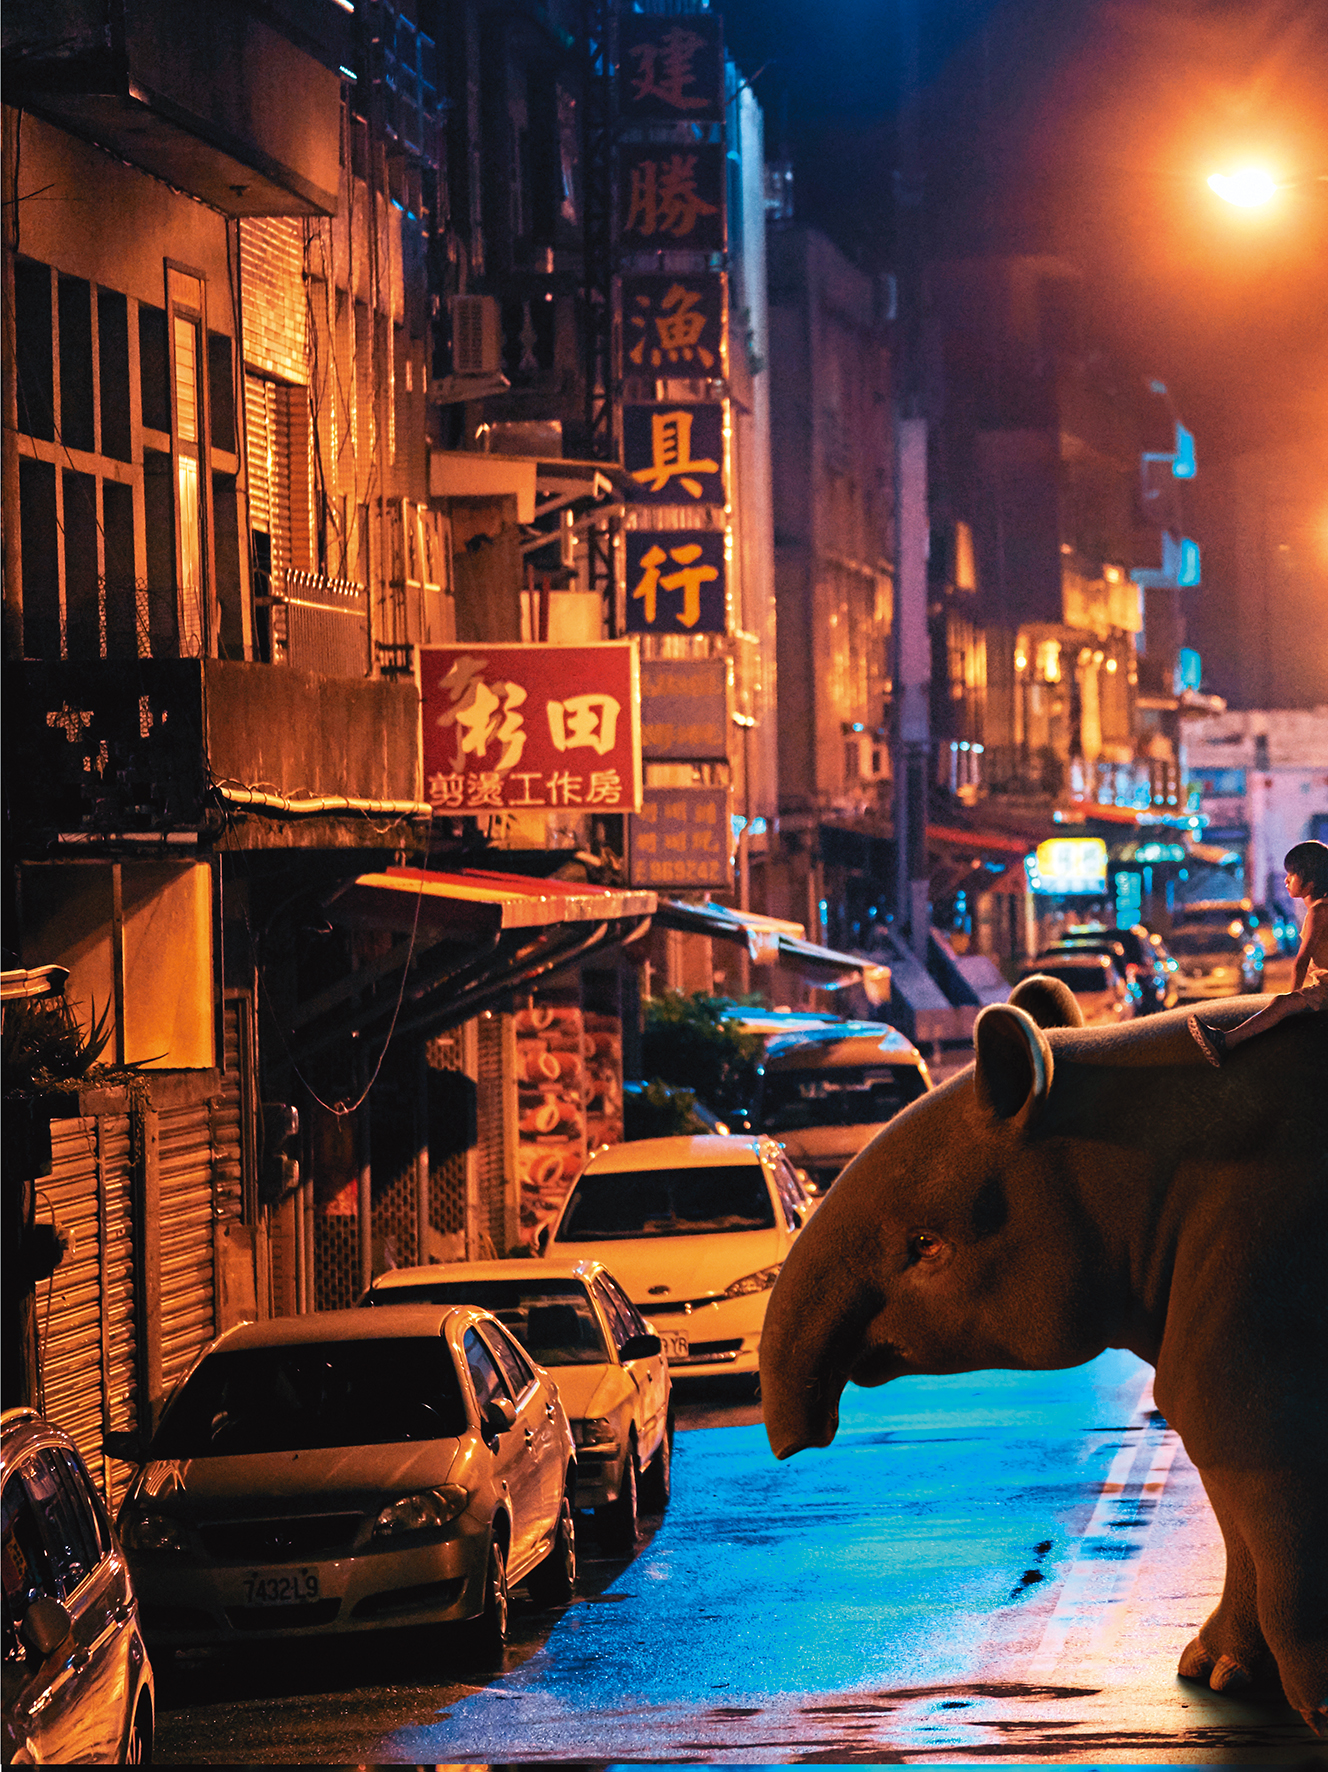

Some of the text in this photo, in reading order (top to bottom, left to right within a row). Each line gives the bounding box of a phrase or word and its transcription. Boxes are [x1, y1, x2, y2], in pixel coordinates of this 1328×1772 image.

[624, 26, 719, 628] 建勝漁具行
[428, 768, 622, 807] 剪燙工作房
